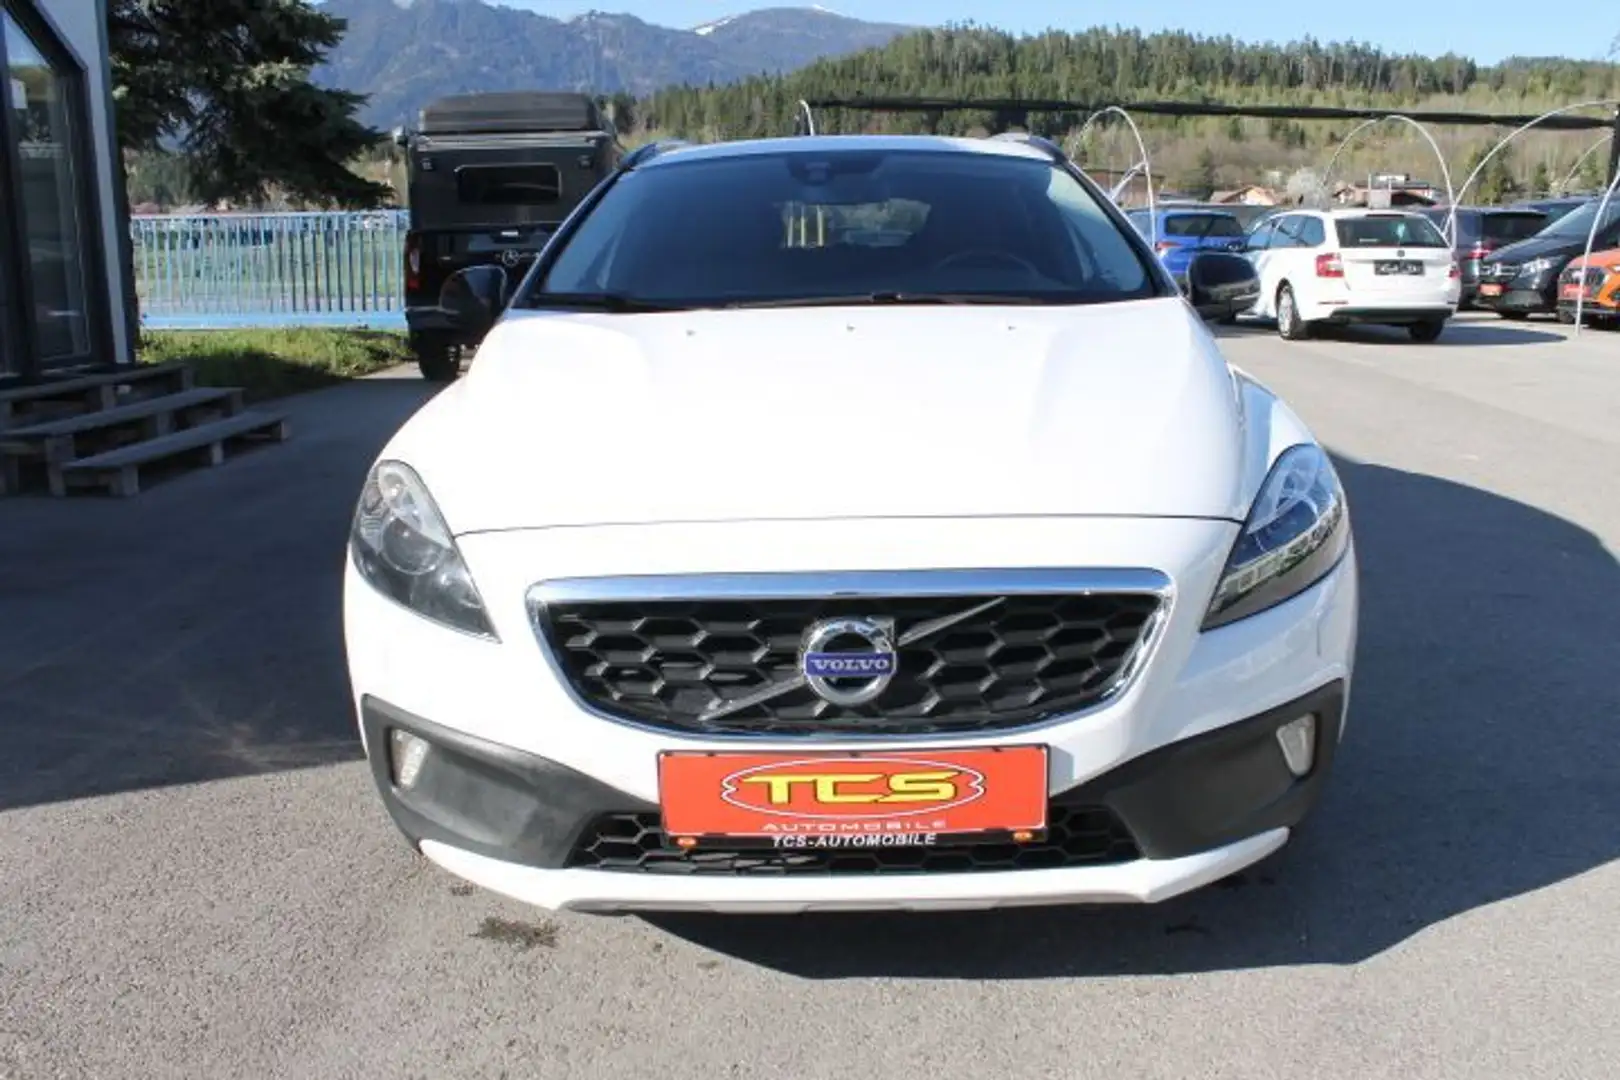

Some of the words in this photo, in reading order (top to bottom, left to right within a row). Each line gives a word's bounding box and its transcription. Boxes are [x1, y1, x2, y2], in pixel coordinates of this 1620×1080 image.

[810, 659, 889, 670] VOLVO
[742, 771, 959, 804] TCS
[762, 820, 946, 832] AUTOMOBILE
[772, 832, 936, 848] TCS-AUTOMOBILE
